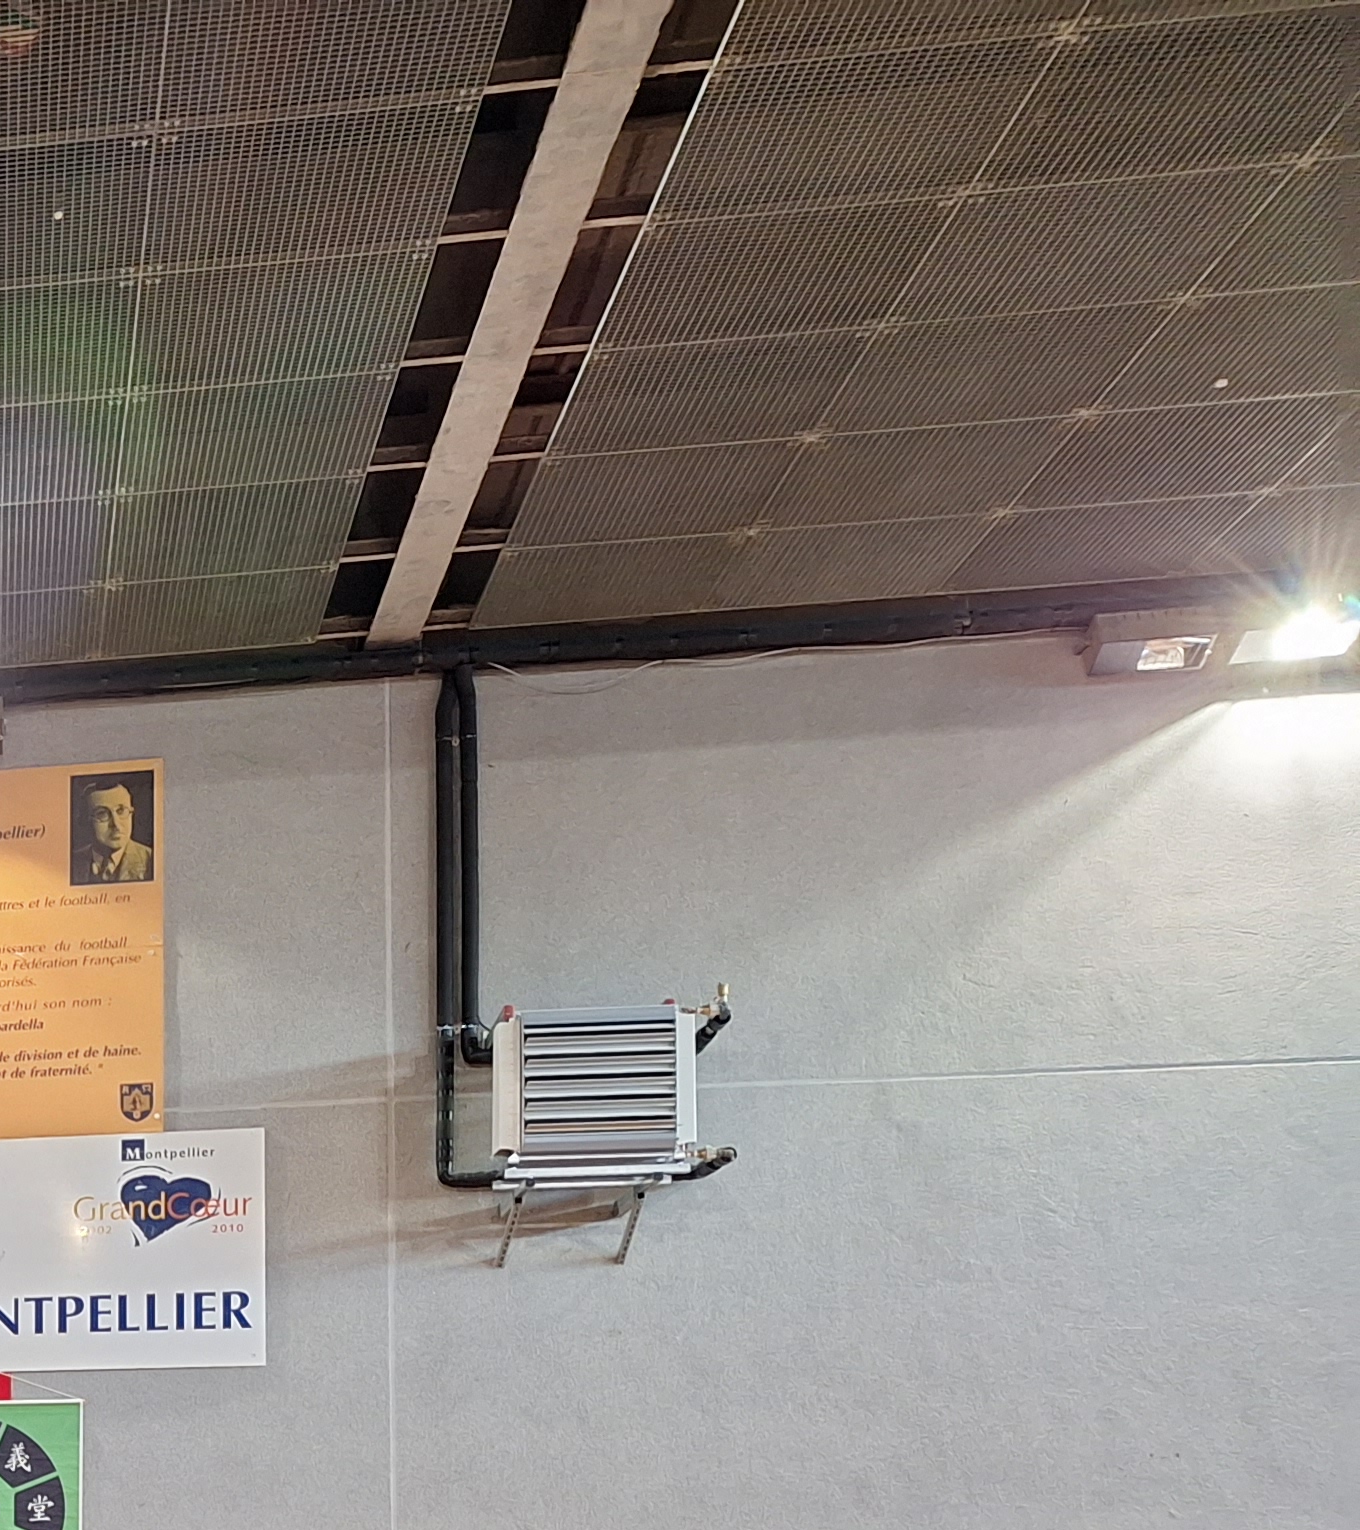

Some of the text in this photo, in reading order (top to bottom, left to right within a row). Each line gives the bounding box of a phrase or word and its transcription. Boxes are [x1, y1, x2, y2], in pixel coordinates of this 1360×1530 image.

[28, 898, 40, 910] et
[45, 896, 56, 908] le
[115, 894, 131, 903] en
[54, 940, 71, 952] du
[80, 936, 128, 951] football
[13, 955, 77, 971] Fédération
[82, 953, 142, 967] Française
[43, 1000, 66, 1009] son
[72, 998, 102, 1008] nom
[14, 1049, 63, 1062] division
[67, 1048, 79, 1059] et
[83, 1046, 99, 1058] de
[10, 1066, 26, 1079] de
[125, 1146, 215, 1161] Montpellier
[212, 1223, 244, 1233] 2010
[4, 1442, 31, 1472] 義
[27, 1494, 54, 1523] 堂
